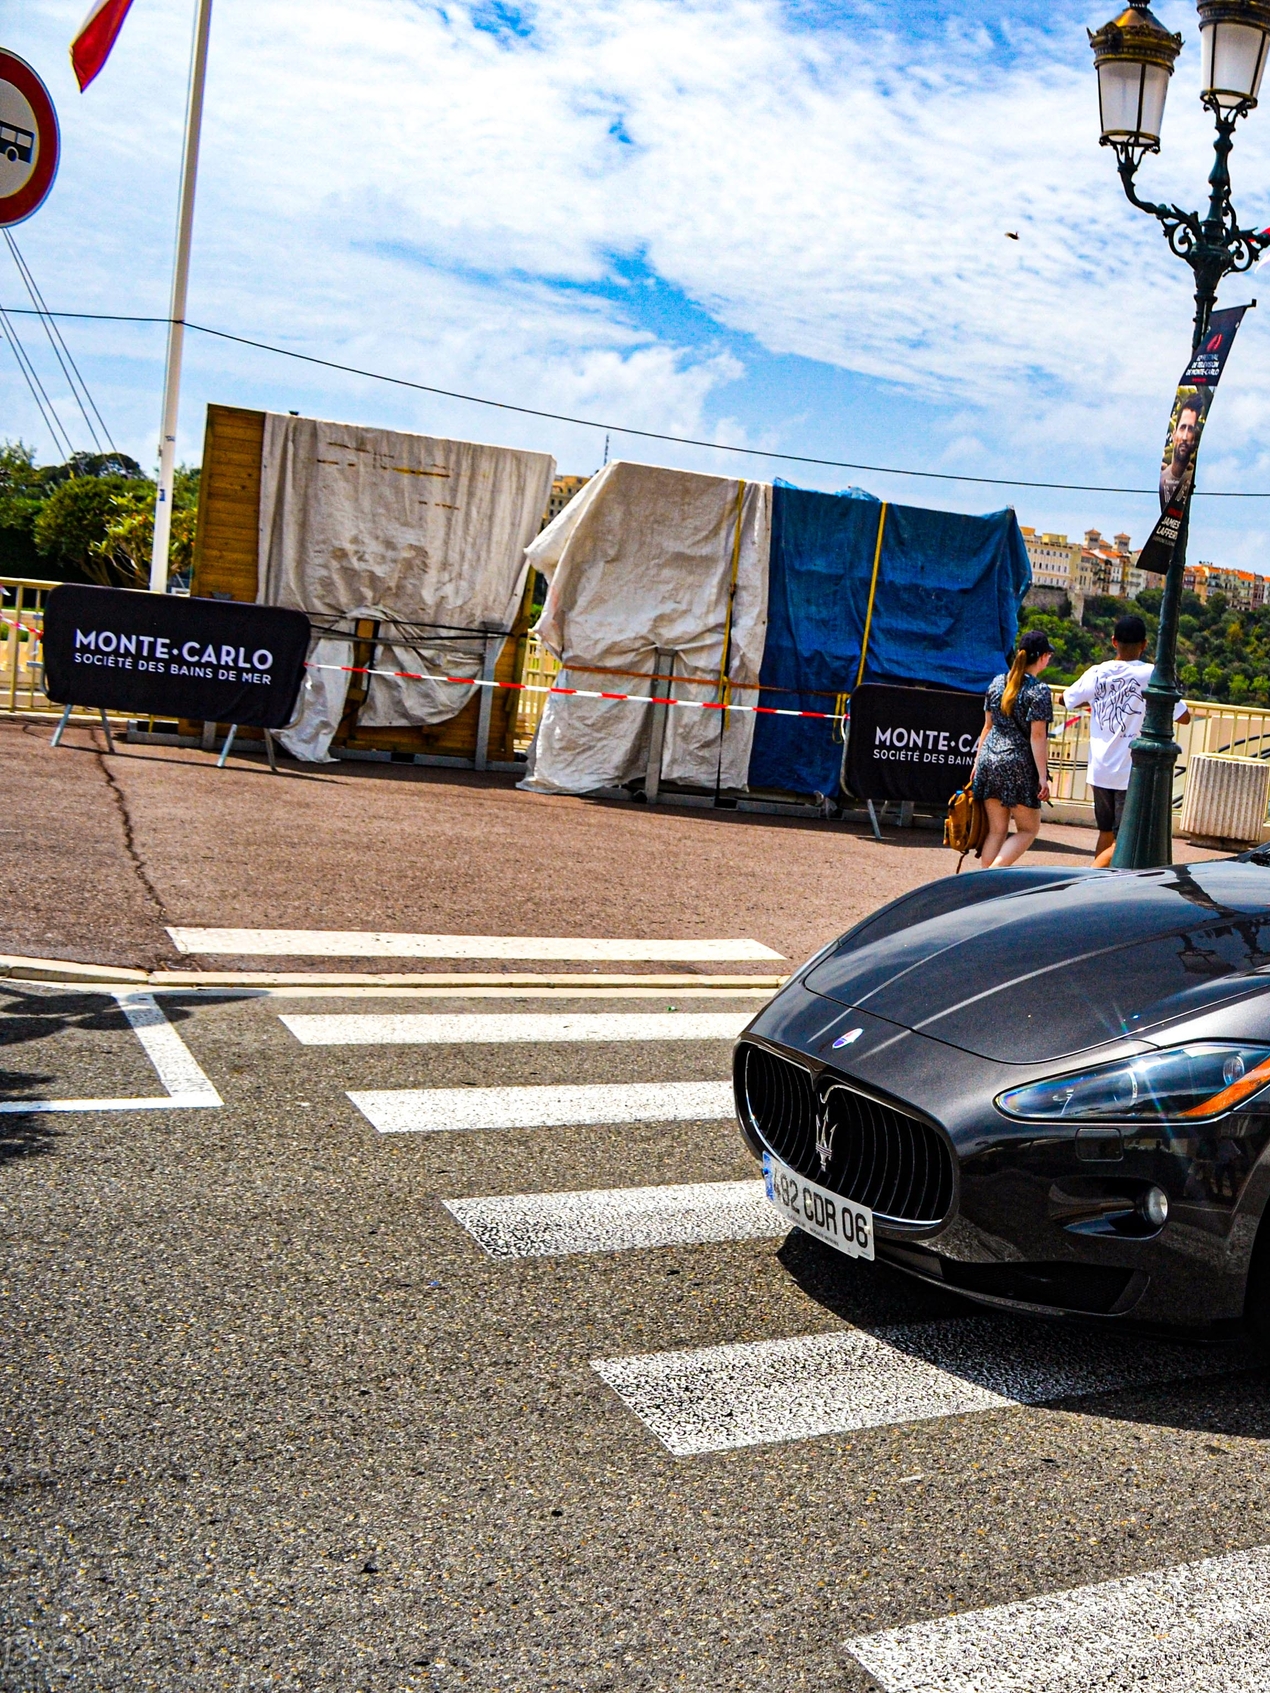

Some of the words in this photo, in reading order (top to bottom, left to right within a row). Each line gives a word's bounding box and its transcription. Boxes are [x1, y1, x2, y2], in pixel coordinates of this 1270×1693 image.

[74, 652, 133, 670] SOCIÉTÉ
[138, 660, 165, 673] DES
[170, 663, 213, 679] BAINS
[218, 669, 237, 682] DE
[242, 672, 272, 685] MER
[873, 749, 920, 762] SOCIÉTÉ
[923, 752, 945, 764] DES
[948, 755, 973, 766] BAIN
[803, 1187, 837, 1236] CDR
[841, 1206, 869, 1249] 06
